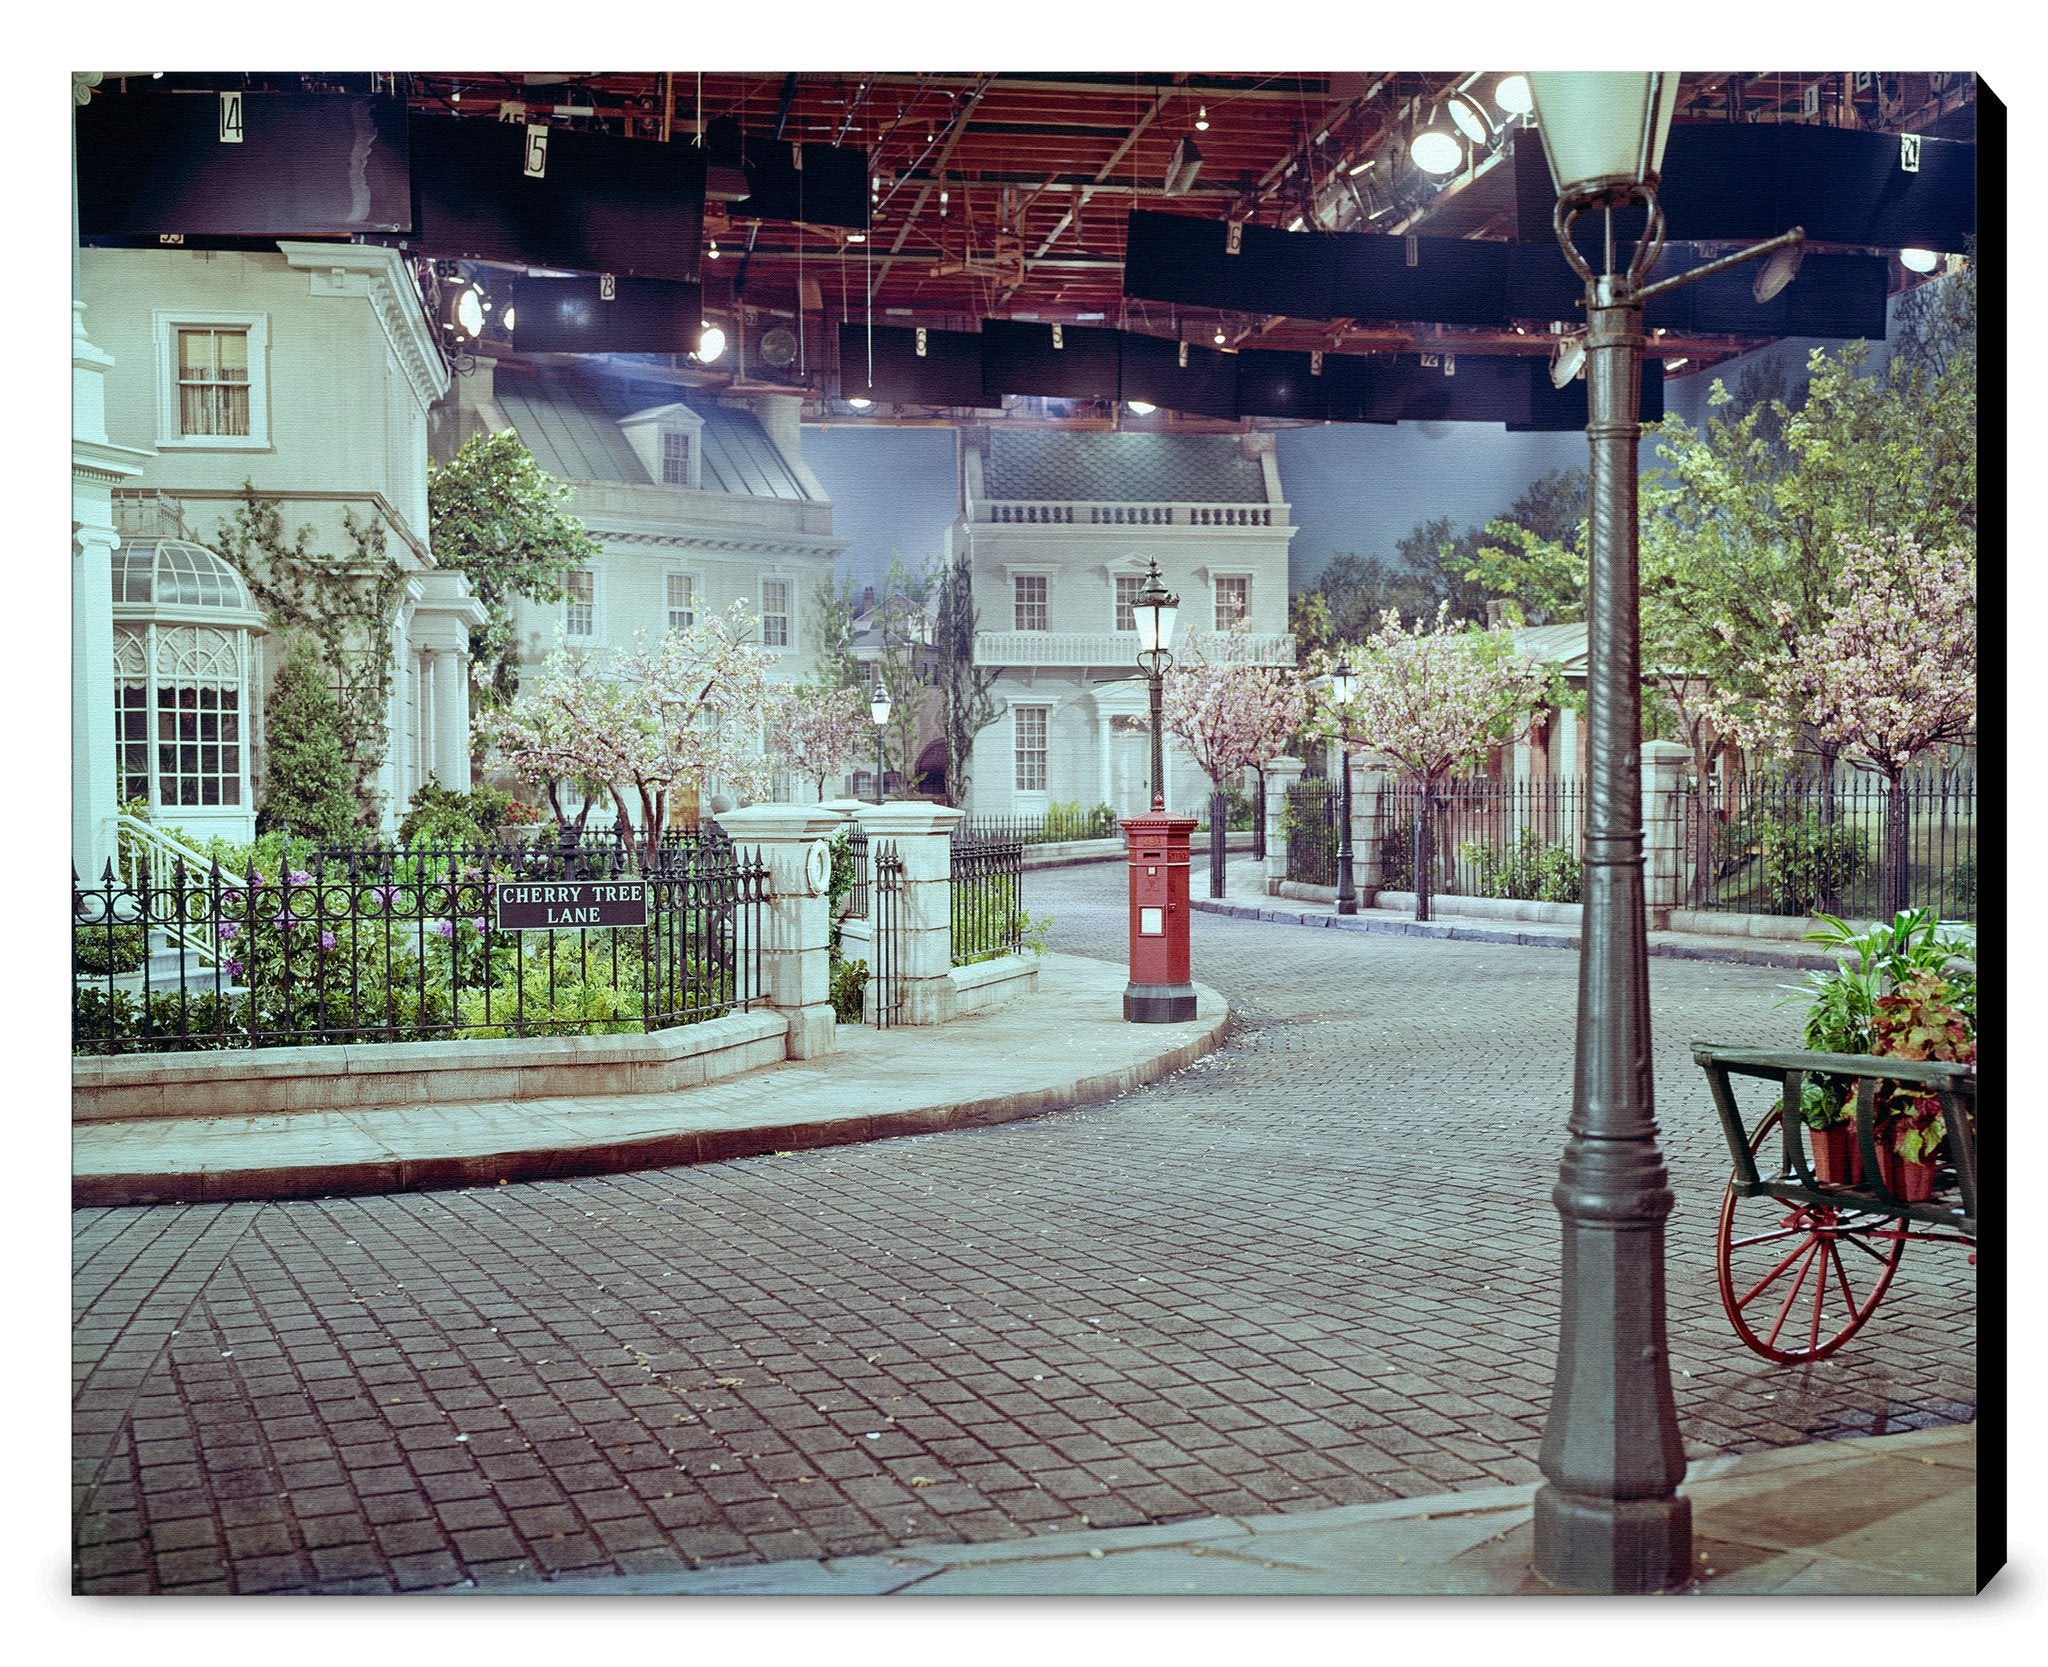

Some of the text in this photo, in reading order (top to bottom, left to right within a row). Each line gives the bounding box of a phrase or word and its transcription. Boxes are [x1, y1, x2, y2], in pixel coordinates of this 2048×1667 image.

[221, 96, 242, 138] 14
[525, 133, 548, 173] 15
[502, 885, 642, 904] CHERRY TREE
[547, 907, 601, 924] LANE
